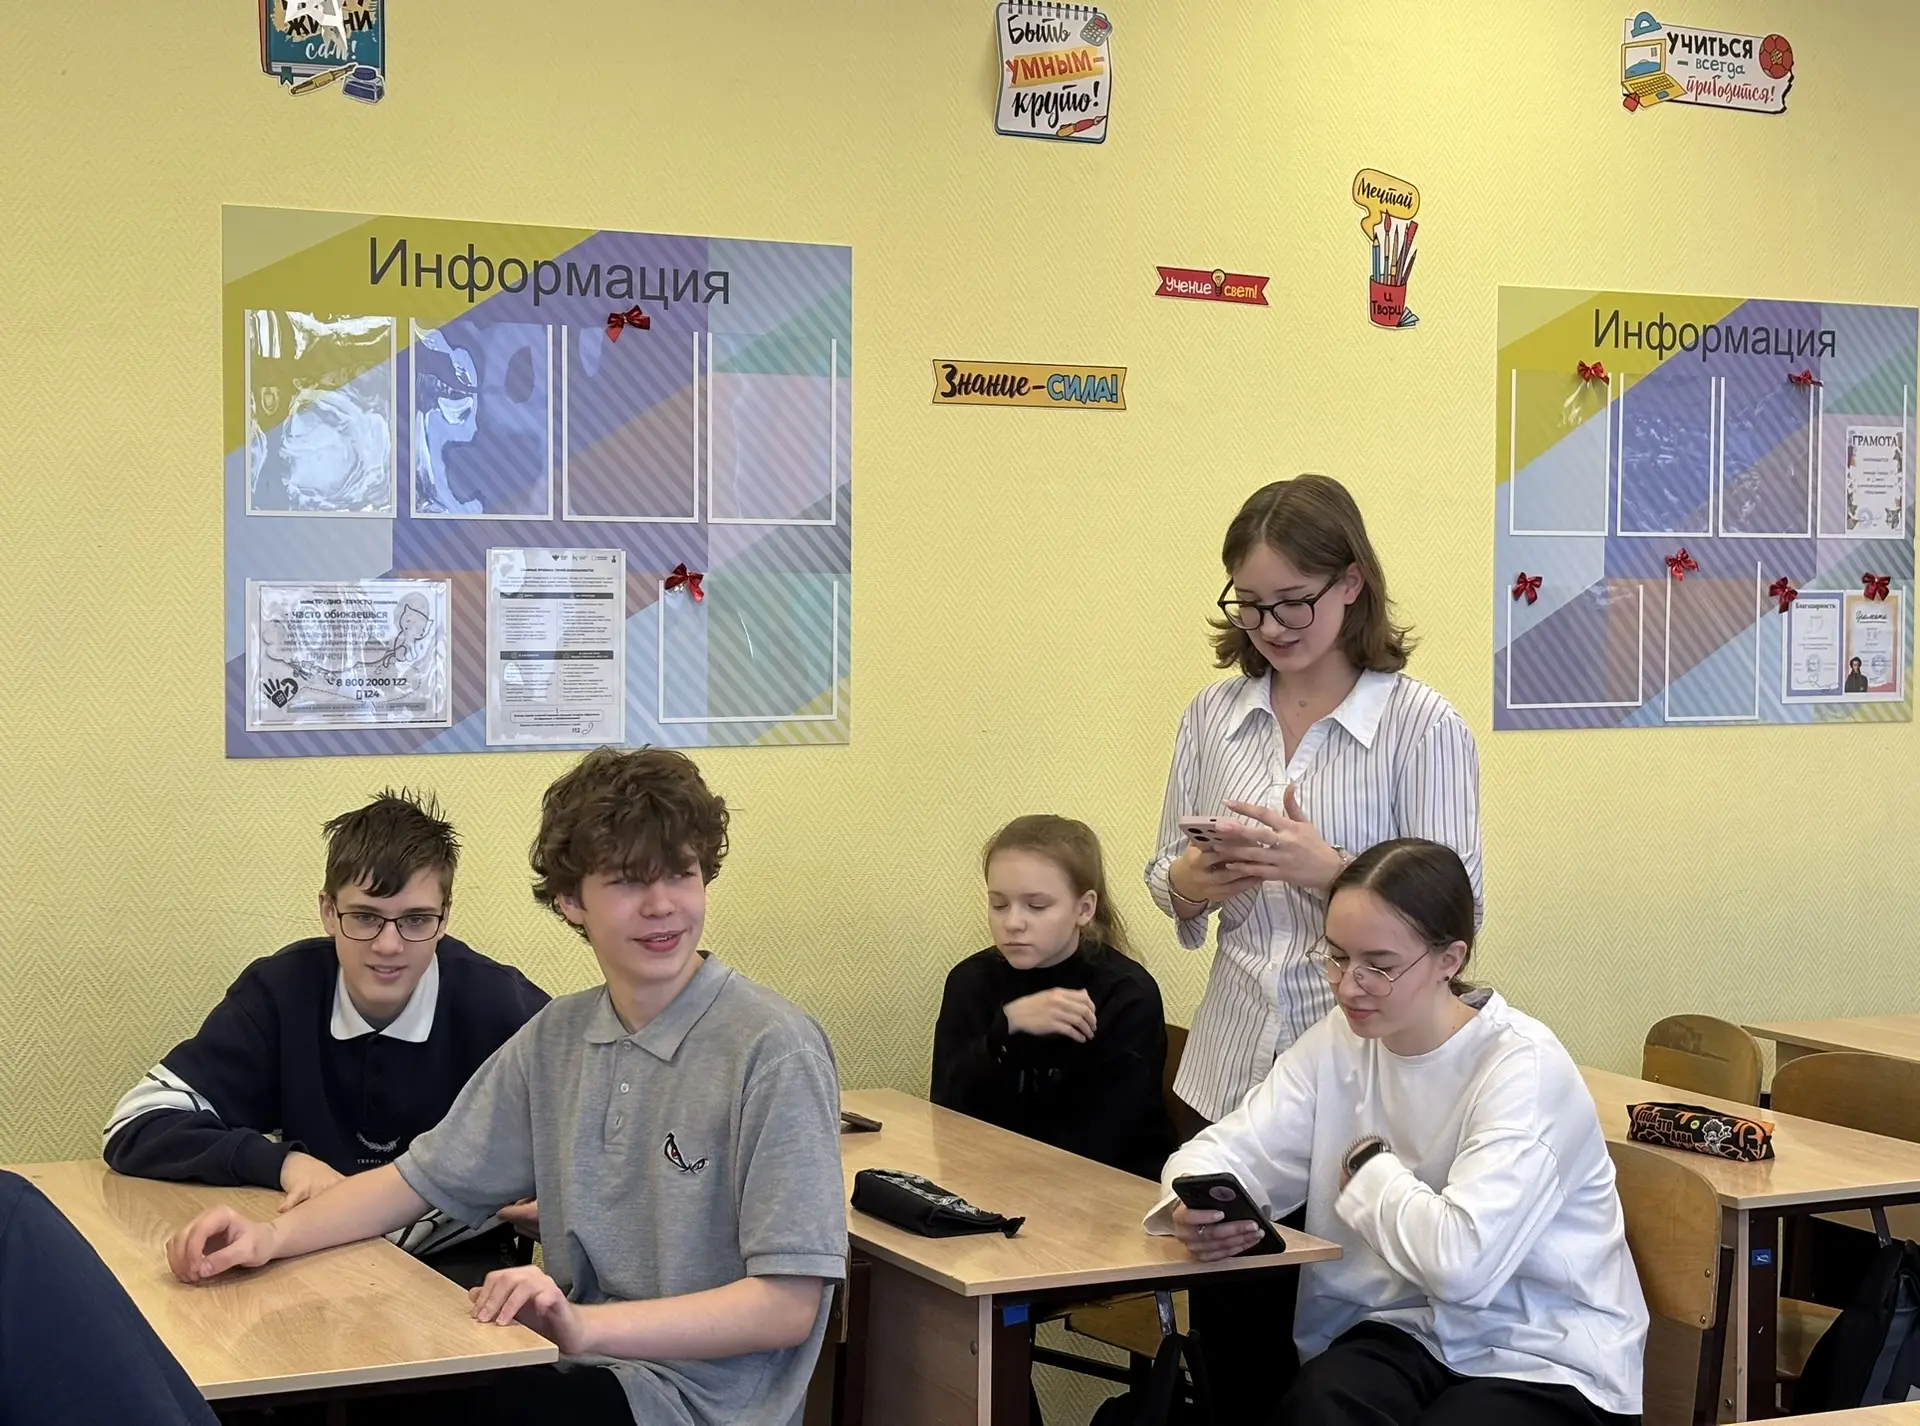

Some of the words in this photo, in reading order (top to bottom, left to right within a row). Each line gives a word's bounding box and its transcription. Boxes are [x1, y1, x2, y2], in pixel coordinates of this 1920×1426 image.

[287, 10, 373, 36] ЖИНИ
[1007, 14, 1071, 45] Быть
[1666, 31, 1753, 59] УЧИТЬСЯ
[1695, 59, 1746, 79] всегда
[1011, 80, 1100, 128] круто!
[1357, 177, 1415, 210] Мечтай
[369, 236, 731, 310] Информация
[1224, 284, 1258, 299] свет!
[1594, 308, 1836, 364] Информация
[1852, 435, 1898, 447] ГРАМОТА
[324, 609, 388, 619] обижаешься
[336, 679, 342, 687] 8
[345, 679, 364, 687] 800
[366, 679, 391, 687] 2000
[393, 678, 407, 686] 122
[364, 690, 380, 698] 124
